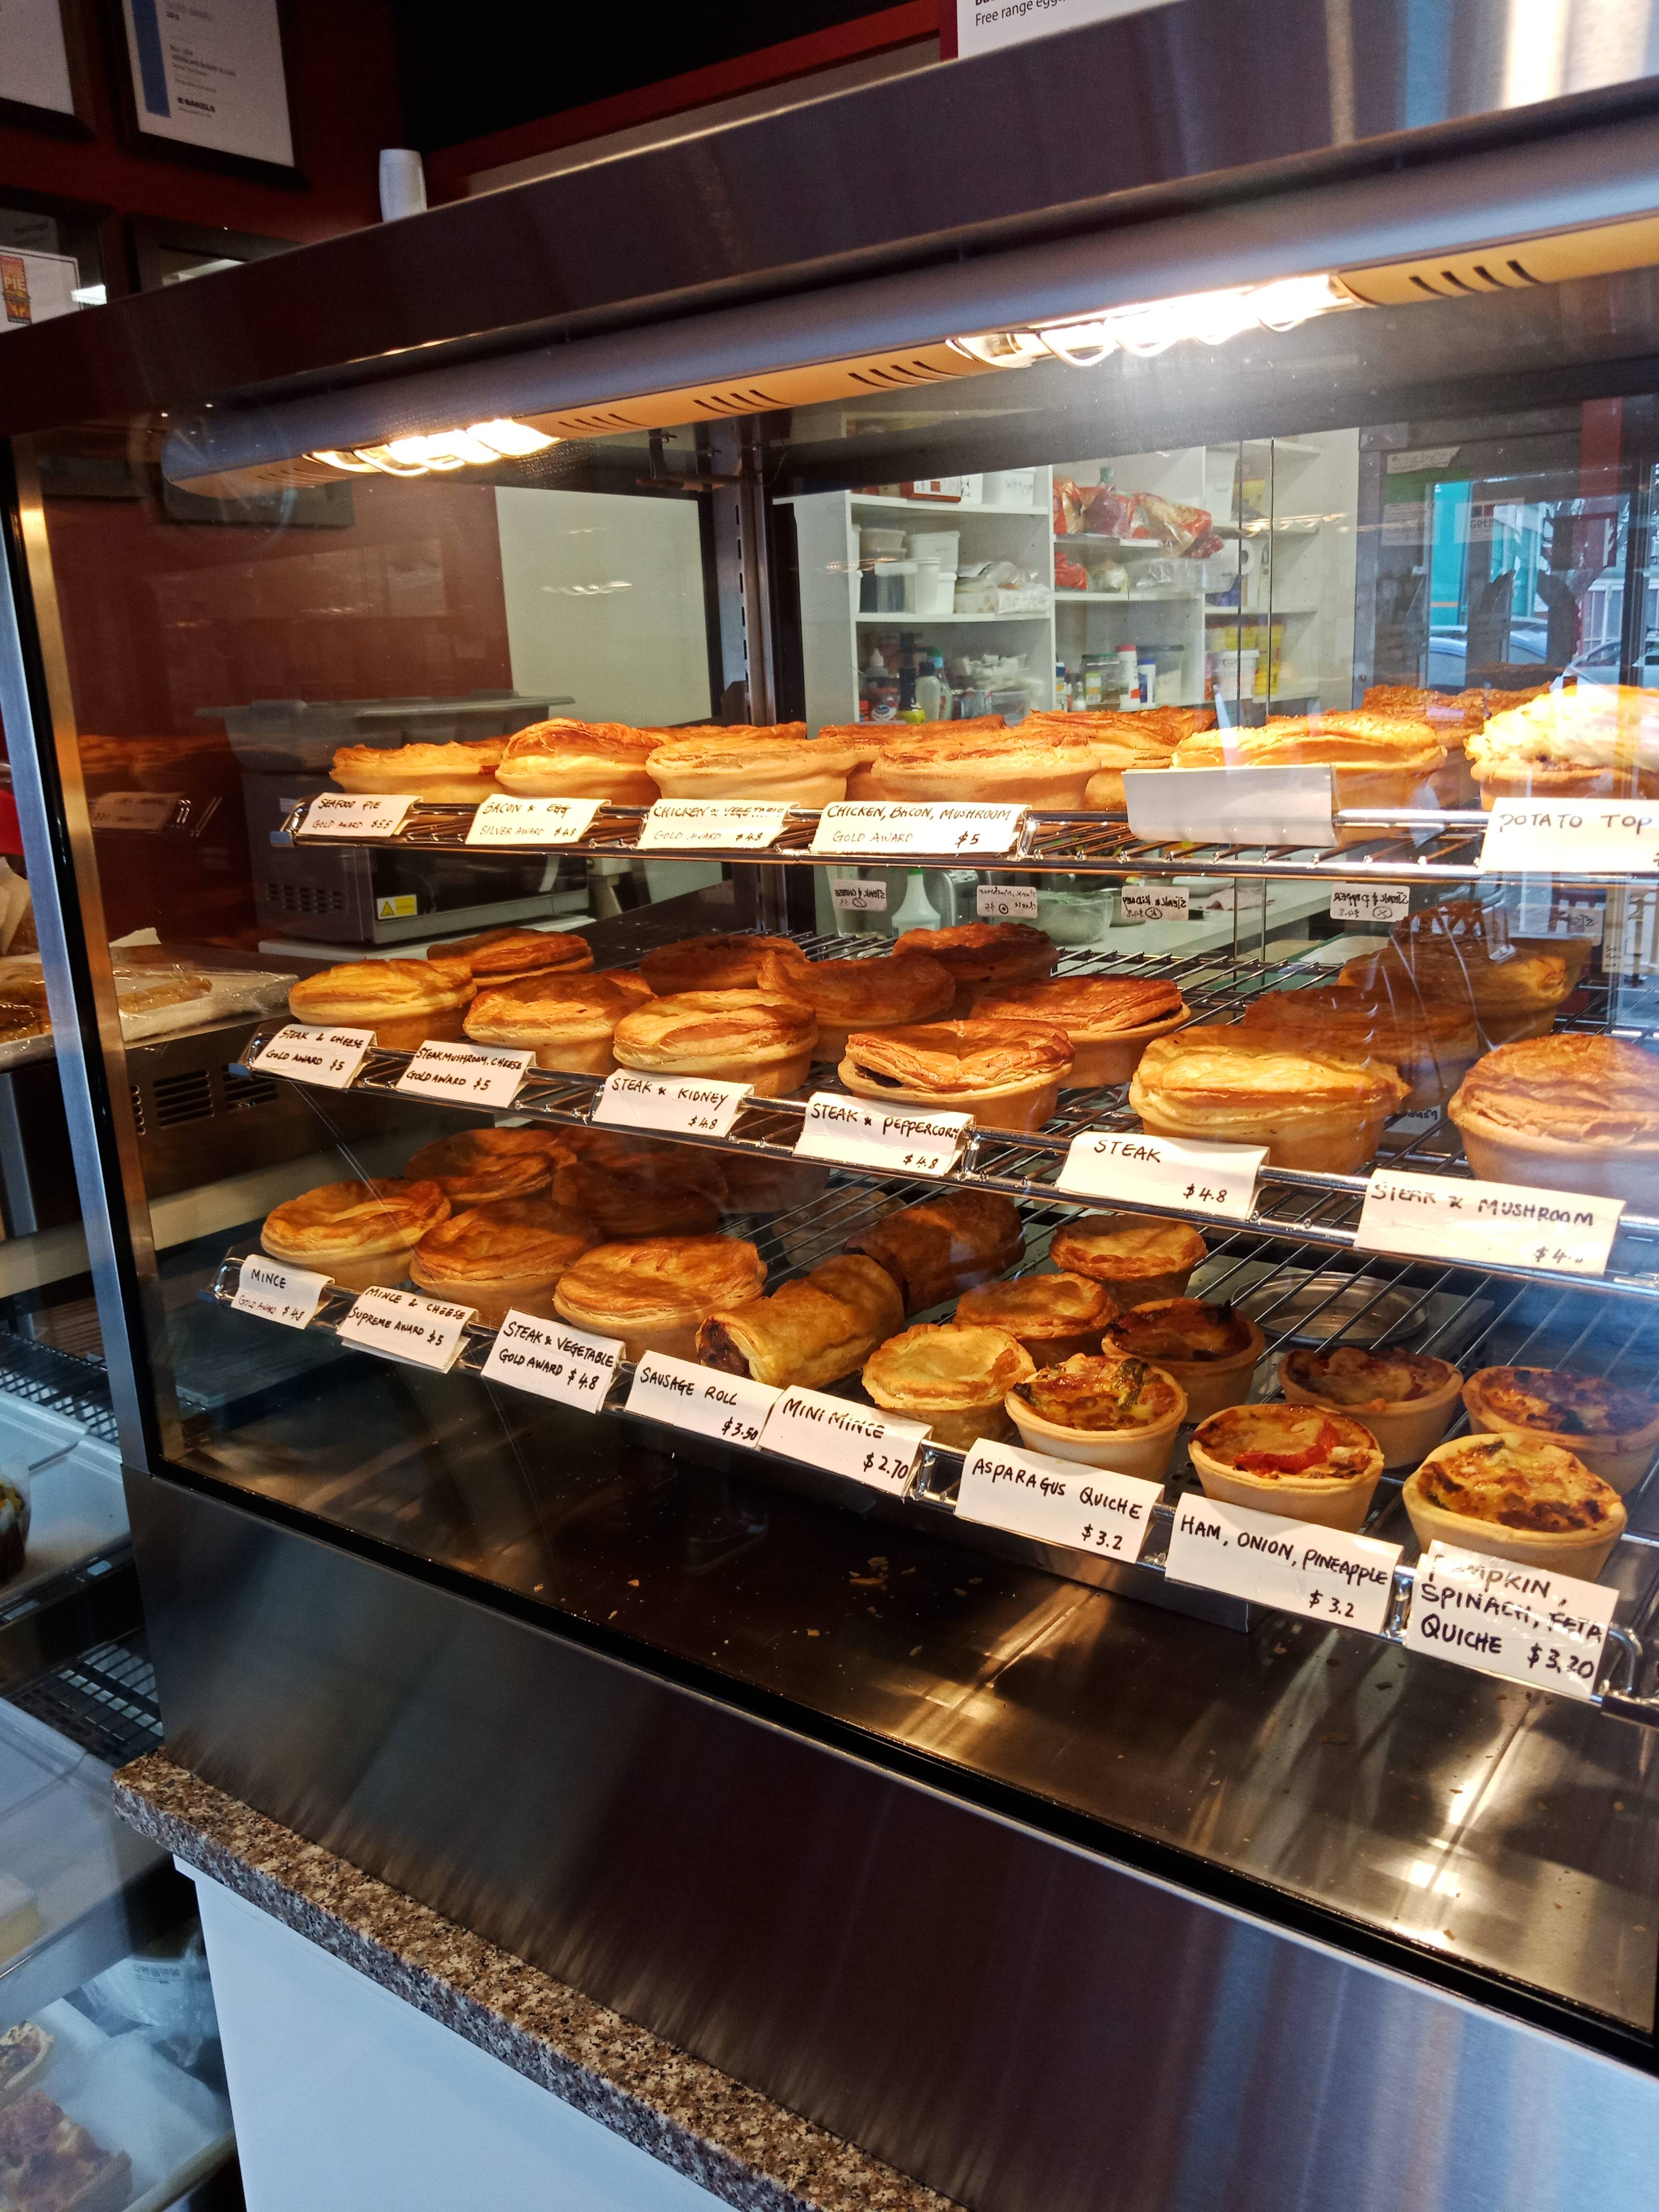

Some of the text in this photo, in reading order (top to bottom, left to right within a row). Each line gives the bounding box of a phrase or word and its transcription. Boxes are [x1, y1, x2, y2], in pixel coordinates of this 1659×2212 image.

[975, 11, 998, 26] Free
[1001, 1, 1033, 19] range
[3, 277, 26, 292] PIE
[318, 798, 382, 810] SEAFOOD PIE
[482, 802, 523, 814] BACON
[546, 804, 572, 818] EGG
[653, 805, 710, 818] CHICKEN
[827, 805, 1012, 821] CHICKEN, BACON, MUSHROOM
[313, 819, 335, 829] GOLD
[338, 820, 363, 829] AWARD
[480, 825, 513, 836] SILVER
[515, 827, 545, 836] AWARD
[653, 830, 684, 840] GOLD
[686, 832, 722, 841] AWARD
[1499, 813, 1653, 835] POTATO TOP
[832, 830, 982, 849] GOLD AWARD $5
[278, 1030, 365, 1048] STEAK & CHEESE
[265, 1049, 346, 1071] GOLD AWARD $5
[416, 1047, 444, 1061] STEAK
[490, 1057, 523, 1070] CHEESE
[406, 1070, 492, 1091] GOLD AWARD $5
[611, 1078, 653, 1094] STEAK
[677, 1087, 730, 1111] KIDNEY
[687, 1115, 719, 1130] $4.8
[810, 1103, 859, 1122] STEAK
[882, 1116, 960, 1140] PEPPERCORN
[902, 1153, 939, 1170] $4.8
[1094, 1139, 1161, 1164] STEAK
[1182, 1183, 1228, 1203] $4.8
[1478, 1198, 1595, 1226] MUSHROOM
[251, 1268, 286, 1289] MINCE
[239, 1295, 257, 1309] GOLD
[257, 1302, 277, 1315] AWARD
[365, 1287, 466, 1320] MINCE & CHEESE
[348, 1306, 445, 1346] SUPREME AWARD $5
[503, 1321, 614, 1368] STEAK & VEGETABLE
[499, 1348, 600, 1391] GOLD AWARD $4.8
[640, 1366, 738, 1406] SAUSAGE ROLL
[721, 1416, 759, 1441] $3.50
[782, 1397, 885, 1439] MINI MINCE
[863, 1452, 910, 1479] $2.70
[972, 1457, 1143, 1520] ASPARAGUS QUICHE
[1081, 1523, 1123, 1551] $3.2
[1237, 1531, 1298, 1567] ONION,
[1302, 1548, 1389, 1587] PINEAPPLE
[1309, 1589, 1355, 1618] $3.2
[1420, 1583, 1603, 1644] SPINACH, FETA
[1420, 1613, 1503, 1655] QUICHE
